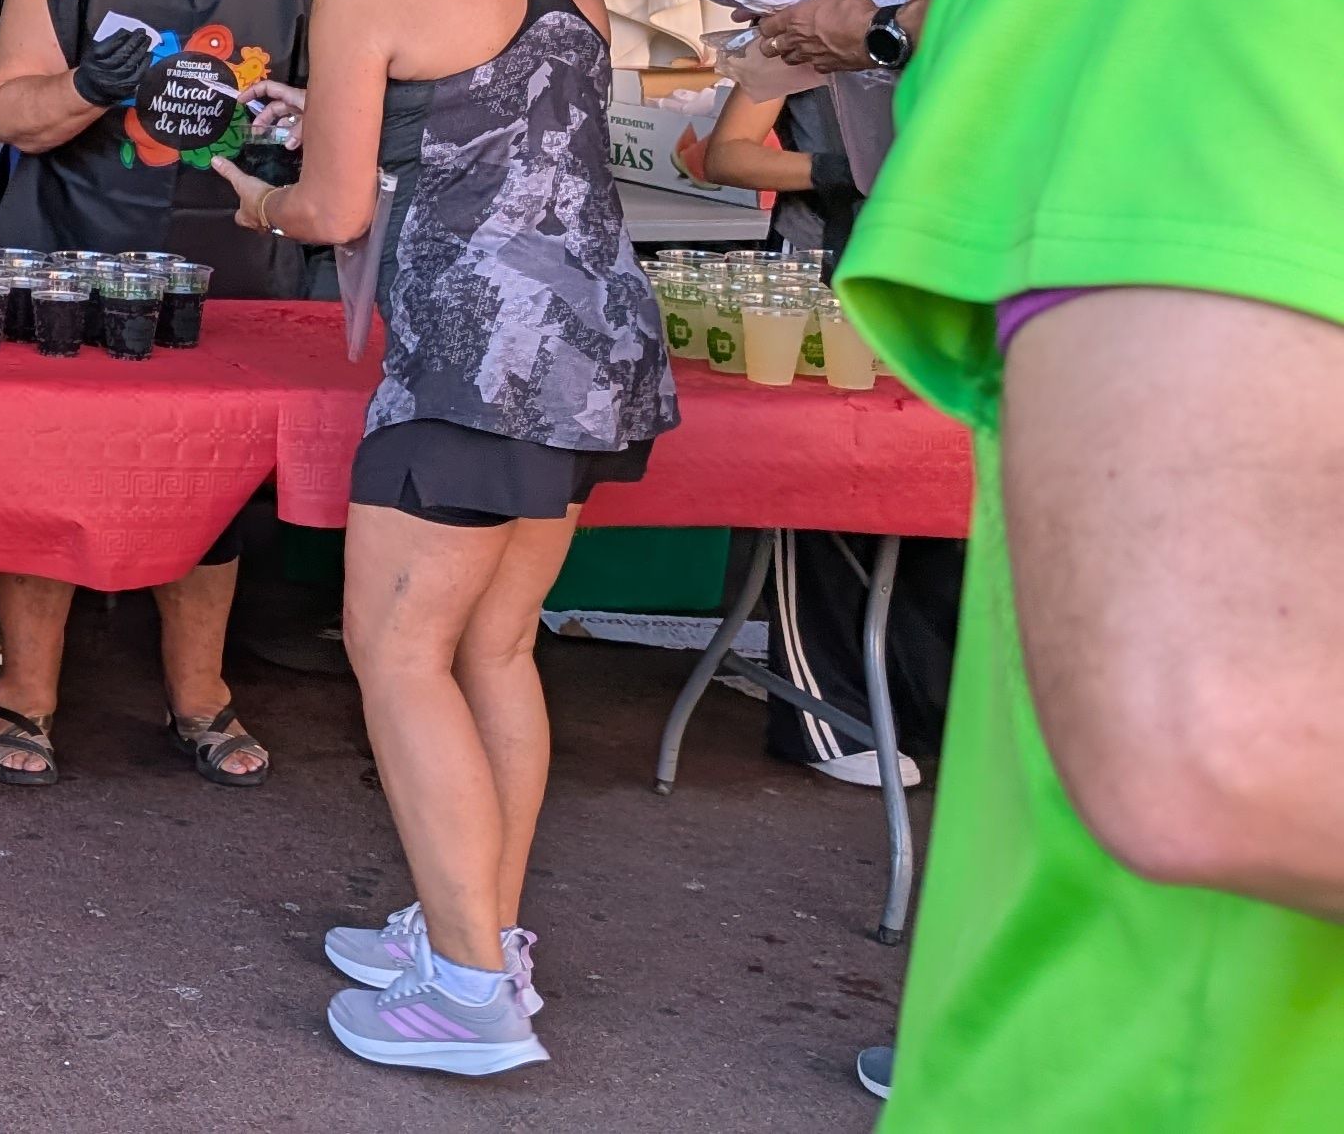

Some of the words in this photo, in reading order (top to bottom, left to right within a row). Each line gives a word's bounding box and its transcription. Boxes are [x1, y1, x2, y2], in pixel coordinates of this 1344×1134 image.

[162, 81, 217, 101] Mercat
[148, 96, 224, 121] Municipal
[155, 113, 177, 134] de
[611, 116, 654, 130] PREMIUM
